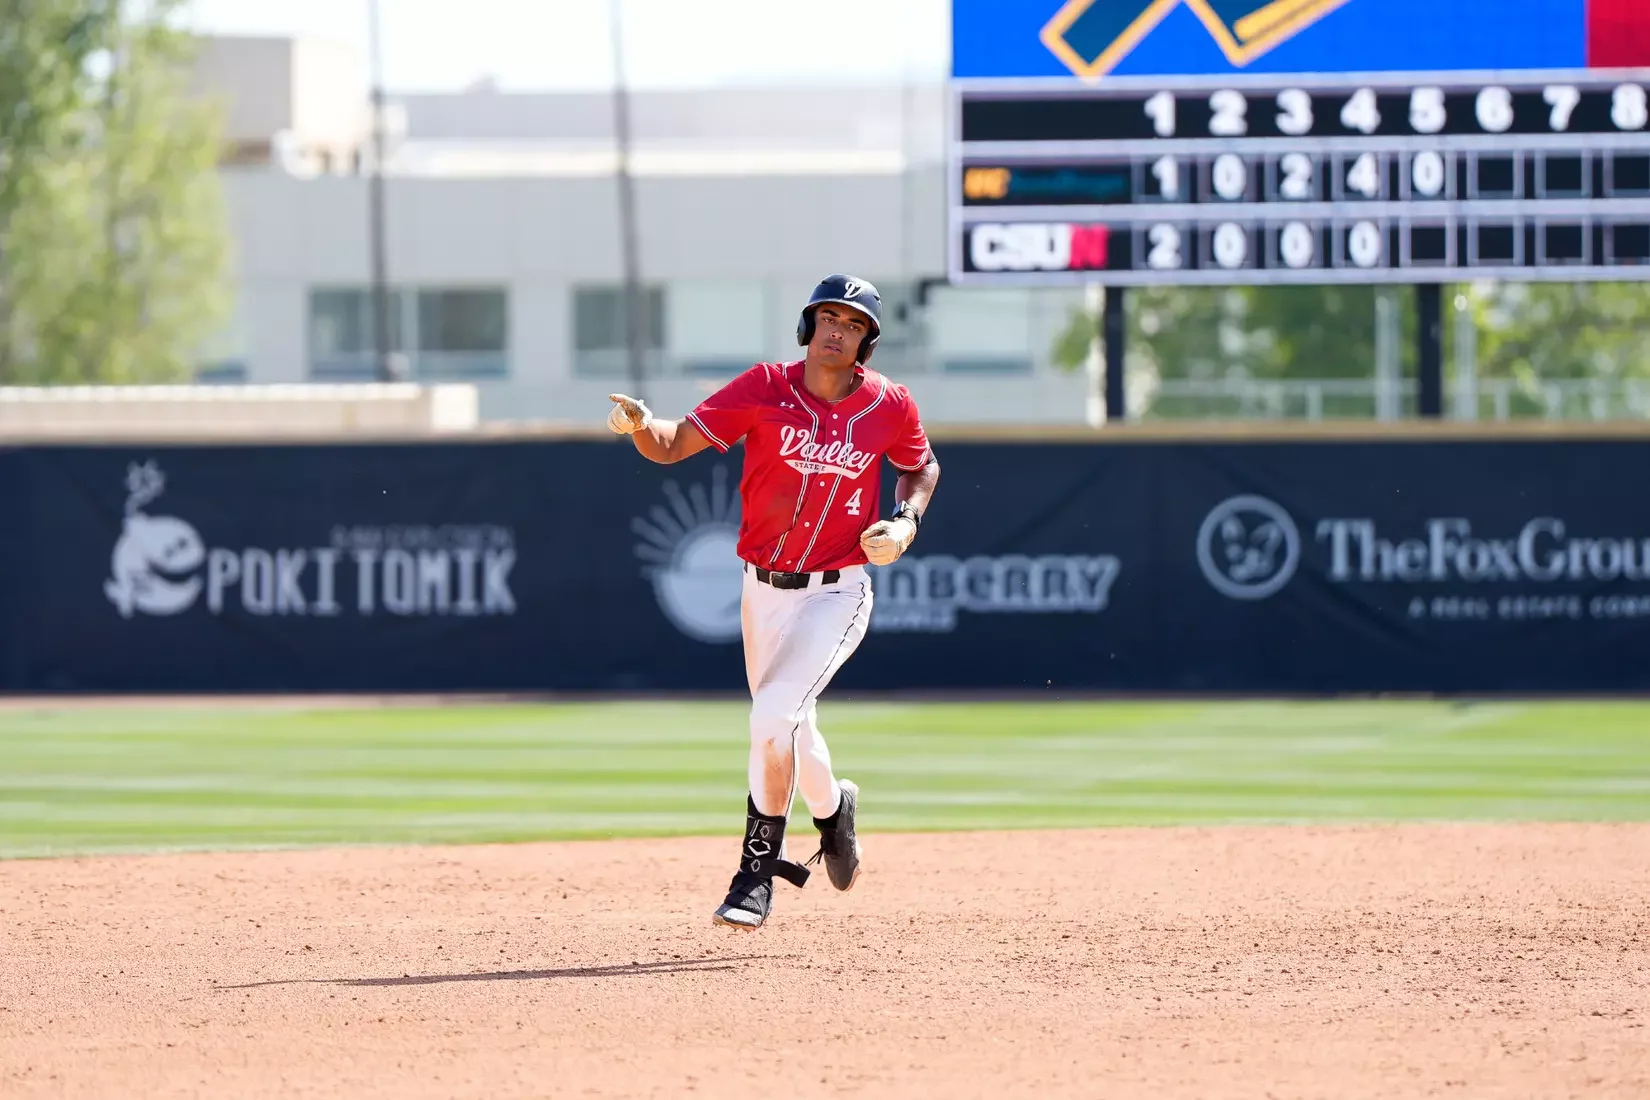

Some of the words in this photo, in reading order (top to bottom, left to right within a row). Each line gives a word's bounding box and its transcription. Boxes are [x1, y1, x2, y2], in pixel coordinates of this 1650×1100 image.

[1144, 90, 1176, 137] 1
[1208, 89, 1248, 136] 2
[1275, 88, 1314, 135] 3
[1340, 86, 1382, 134] 4
[1408, 86, 1447, 134] 5
[1475, 86, 1514, 133] 6
[1543, 85, 1580, 131] 7
[1610, 83, 1648, 130] 8
[1151, 155, 1179, 200] 1
[1212, 153, 1247, 200] 0
[1280, 153, 1312, 198] 2
[1346, 152, 1378, 197] 4
[1412, 150, 1444, 196] 0
[971, 223, 1110, 270] CSUN
[1148, 222, 1182, 269] 2
[1213, 221, 1247, 269] 0
[1281, 220, 1313, 269] 0
[1348, 220, 1380, 268] 0
[843, 281, 863, 299] V
[844, 487, 863, 516] 4
